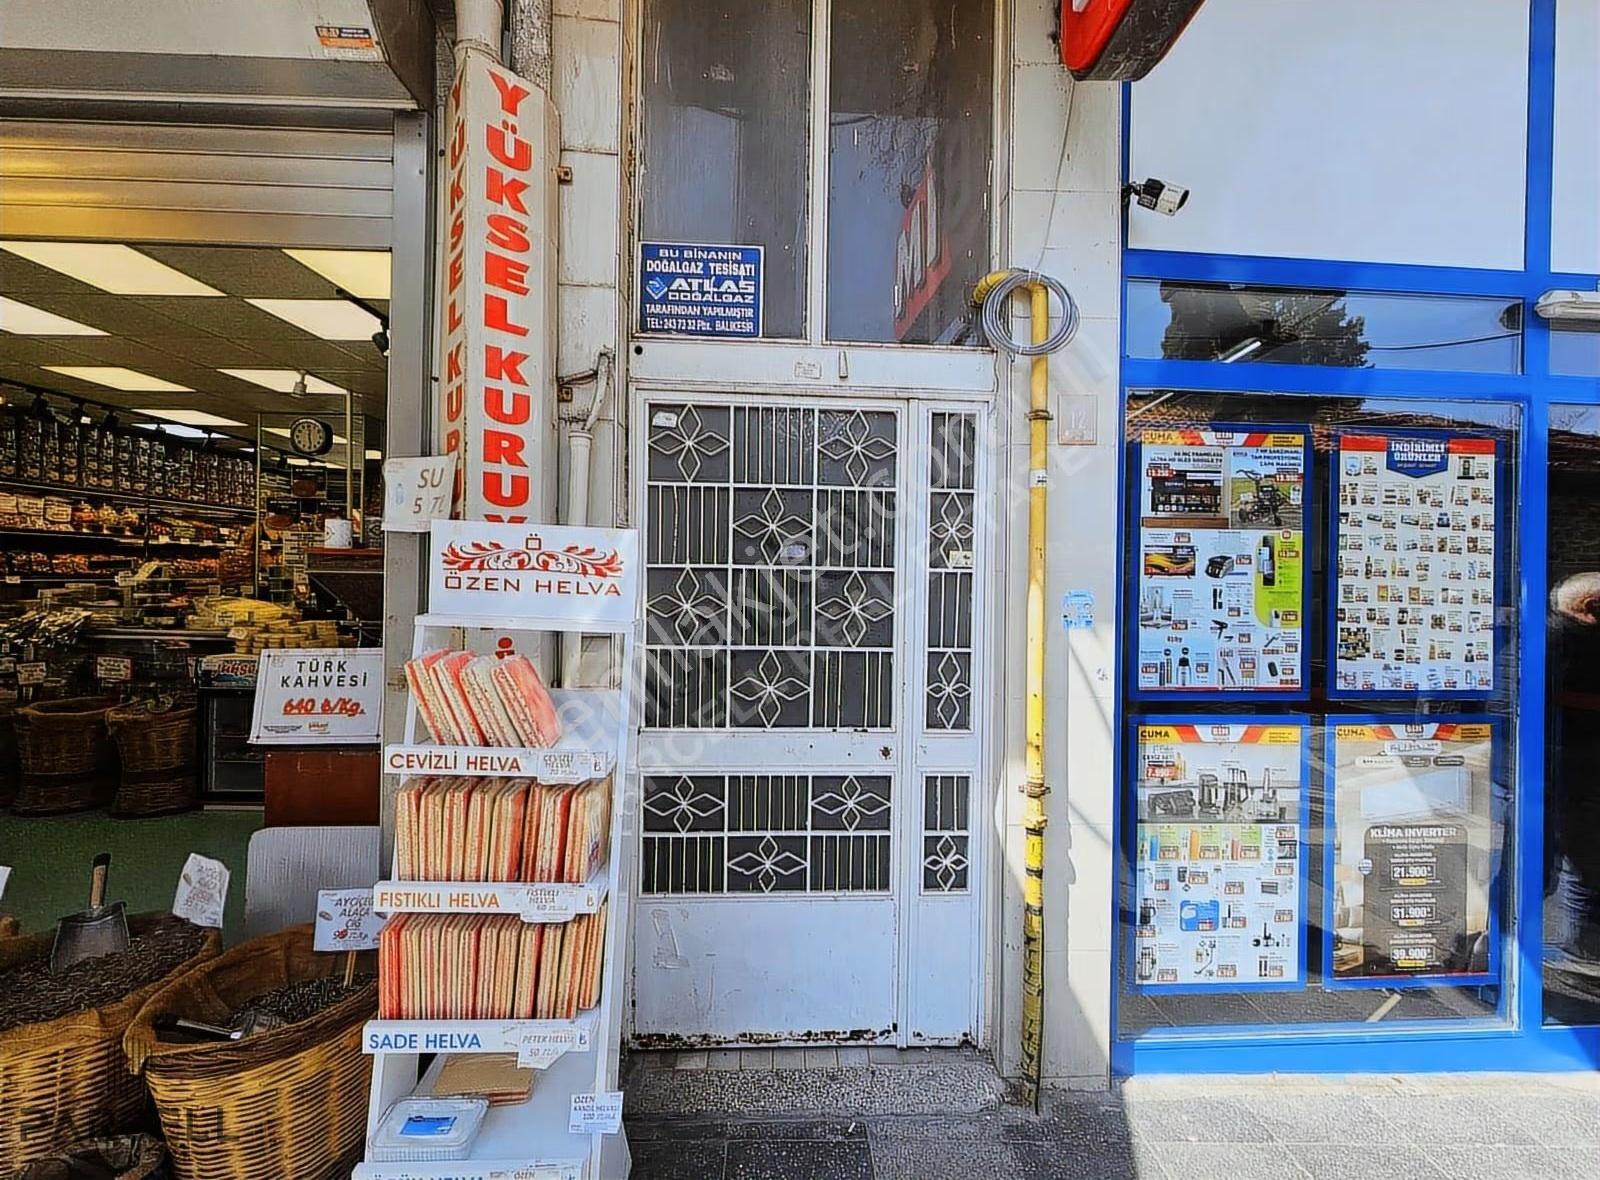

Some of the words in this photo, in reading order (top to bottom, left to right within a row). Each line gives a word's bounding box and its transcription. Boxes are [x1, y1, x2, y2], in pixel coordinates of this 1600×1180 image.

[659, 249, 679, 258] BU
[684, 248, 742, 260] BİNANIN
[646, 259, 704, 274] DOĞALGAZ
[709, 261, 755, 276] TESİSATI
[668, 277, 755, 293] ATLAS
[668, 292, 754, 303] DOĞALGAZ
[646, 304, 700, 316] TARAFINDAN
[715, 319, 754, 332] BALIKESİR
[417, 467, 444, 489] SU
[445, 571, 520, 592] ÖZEN
[535, 579, 621, 597] HELVA
[297, 658, 348, 673] TÜRK
[280, 672, 367, 688] KAHVESİ
[1140, 730, 1170, 738] CUMA
[1337, 728, 1365, 737] CUMA
[389, 751, 457, 770] CEVİZLİ
[466, 755, 521, 772] HELVA
[379, 892, 440, 908] FISTIKLI
[449, 893, 500, 908] HELVA
[368, 1034, 418, 1049] SADE
[425, 1034, 481, 1049] HELVA
